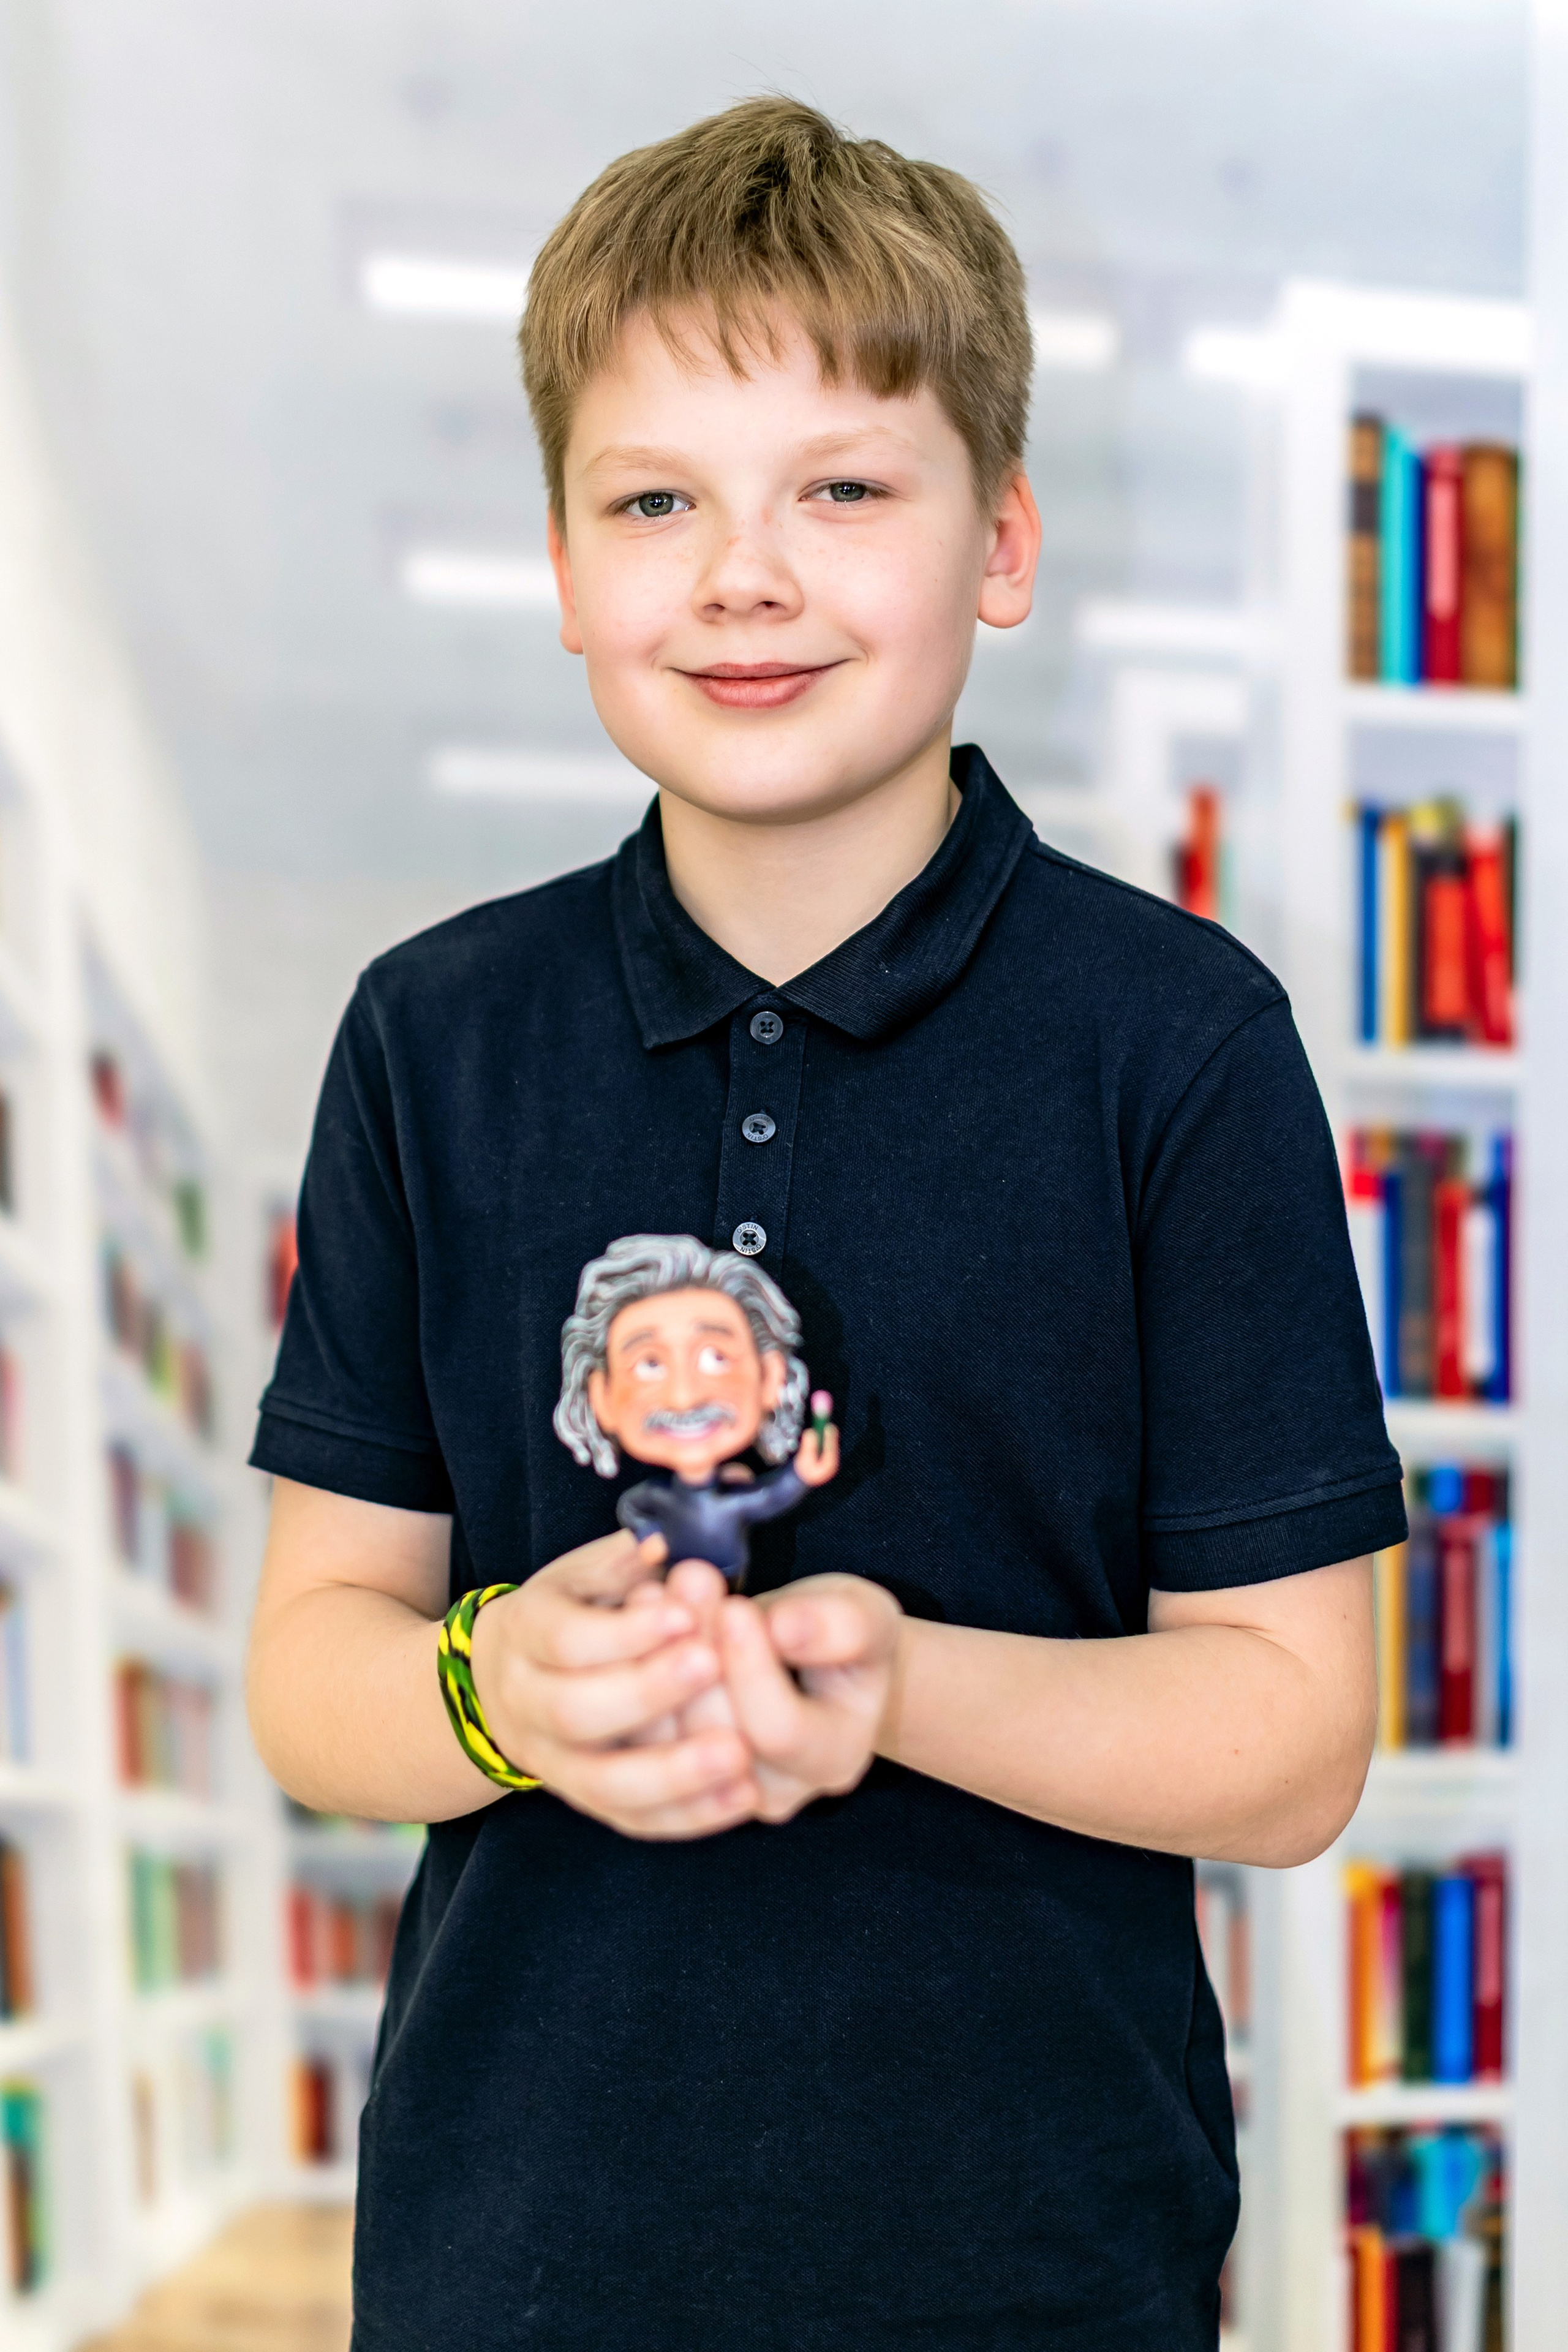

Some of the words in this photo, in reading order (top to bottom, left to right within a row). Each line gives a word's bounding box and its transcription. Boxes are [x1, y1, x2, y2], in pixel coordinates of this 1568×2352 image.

[746, 1133, 769, 1141] O'STIN
[737, 1223, 759, 1234] O'STIN
[740, 1243, 762, 1254] O'STIN
